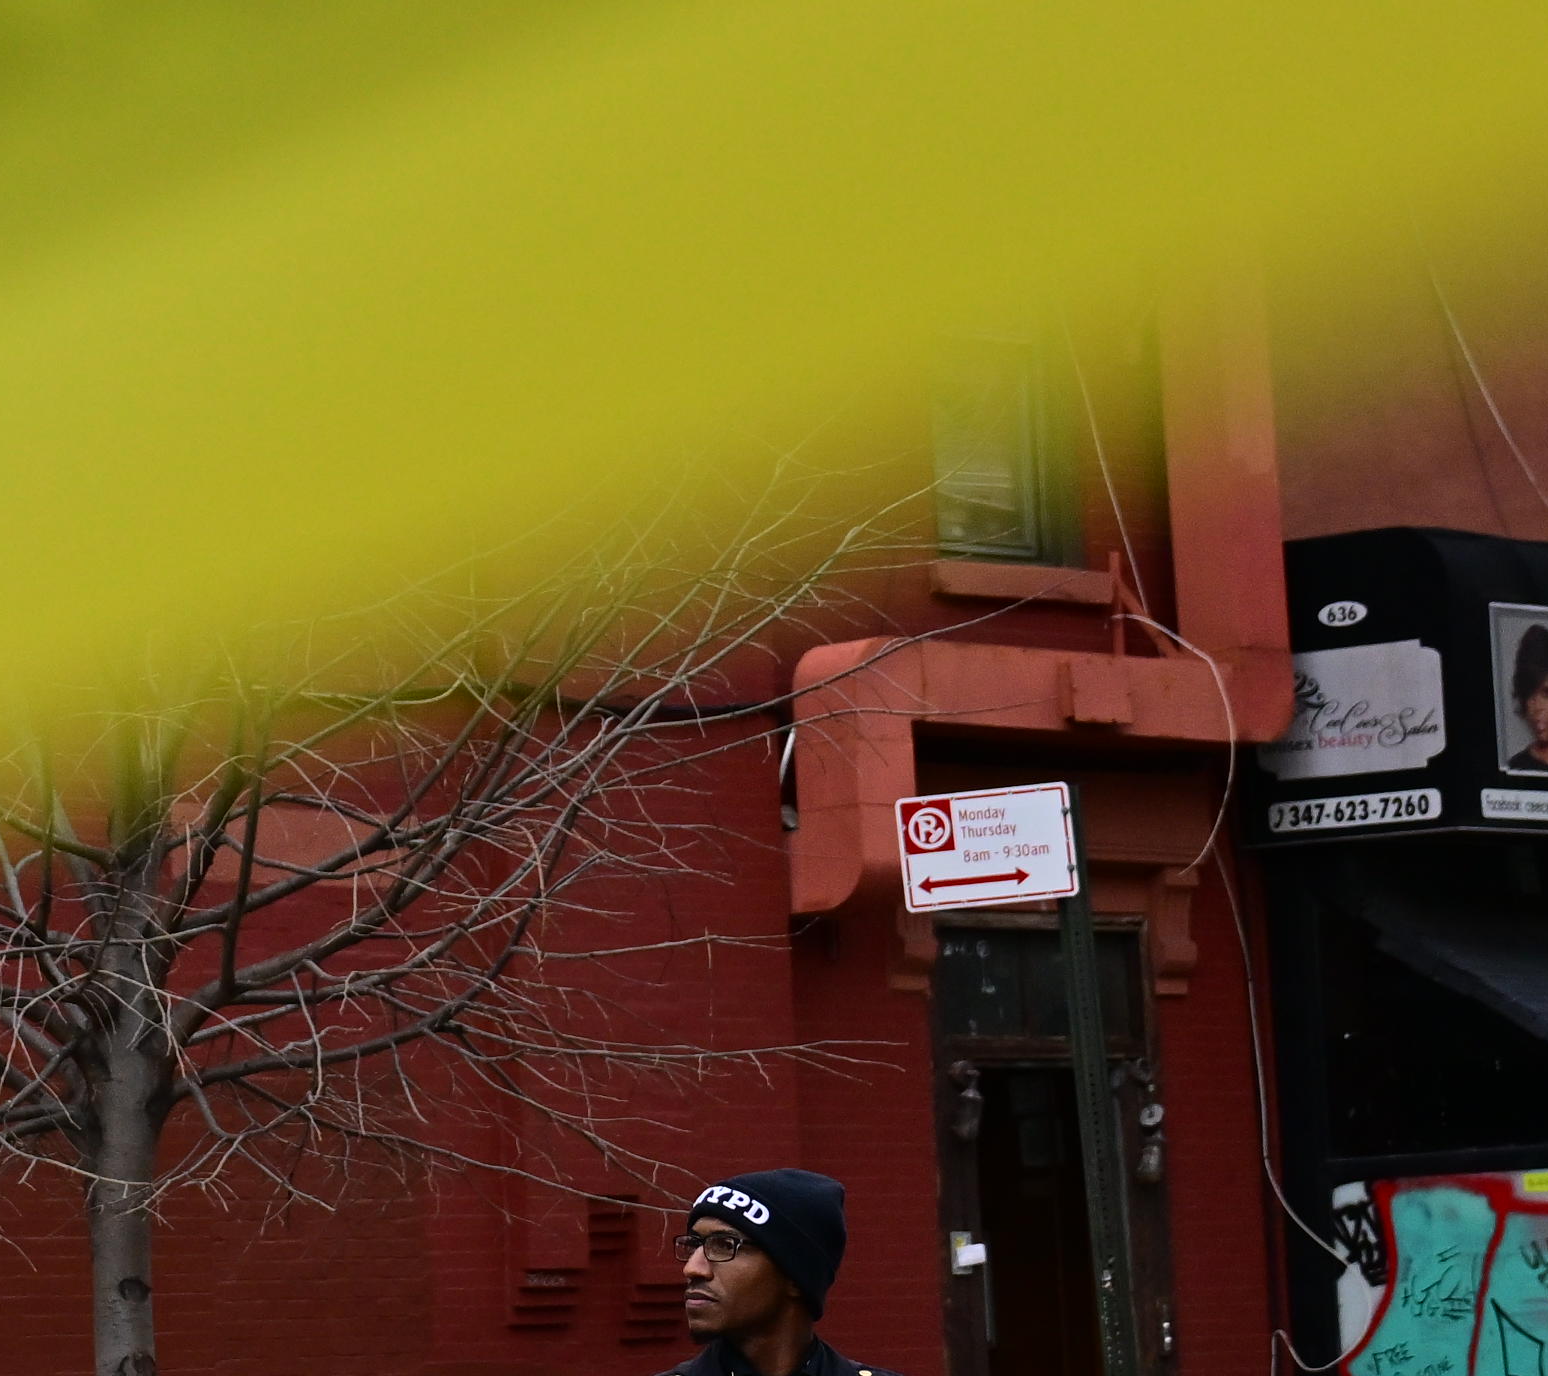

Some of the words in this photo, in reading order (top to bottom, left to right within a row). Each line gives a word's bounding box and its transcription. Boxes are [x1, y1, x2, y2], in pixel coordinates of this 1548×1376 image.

[1327, 605, 1357, 623] 636
[1377, 707, 1439, 748] Salon
[1318, 733, 1374, 750] beauty
[958, 807, 1005, 824] Monday
[1288, 793, 1430, 828] 347-623-7260
[961, 823, 1017, 840] Thursday
[963, 848, 991, 863] 8am
[1002, 842, 1050, 860] 9:30am
